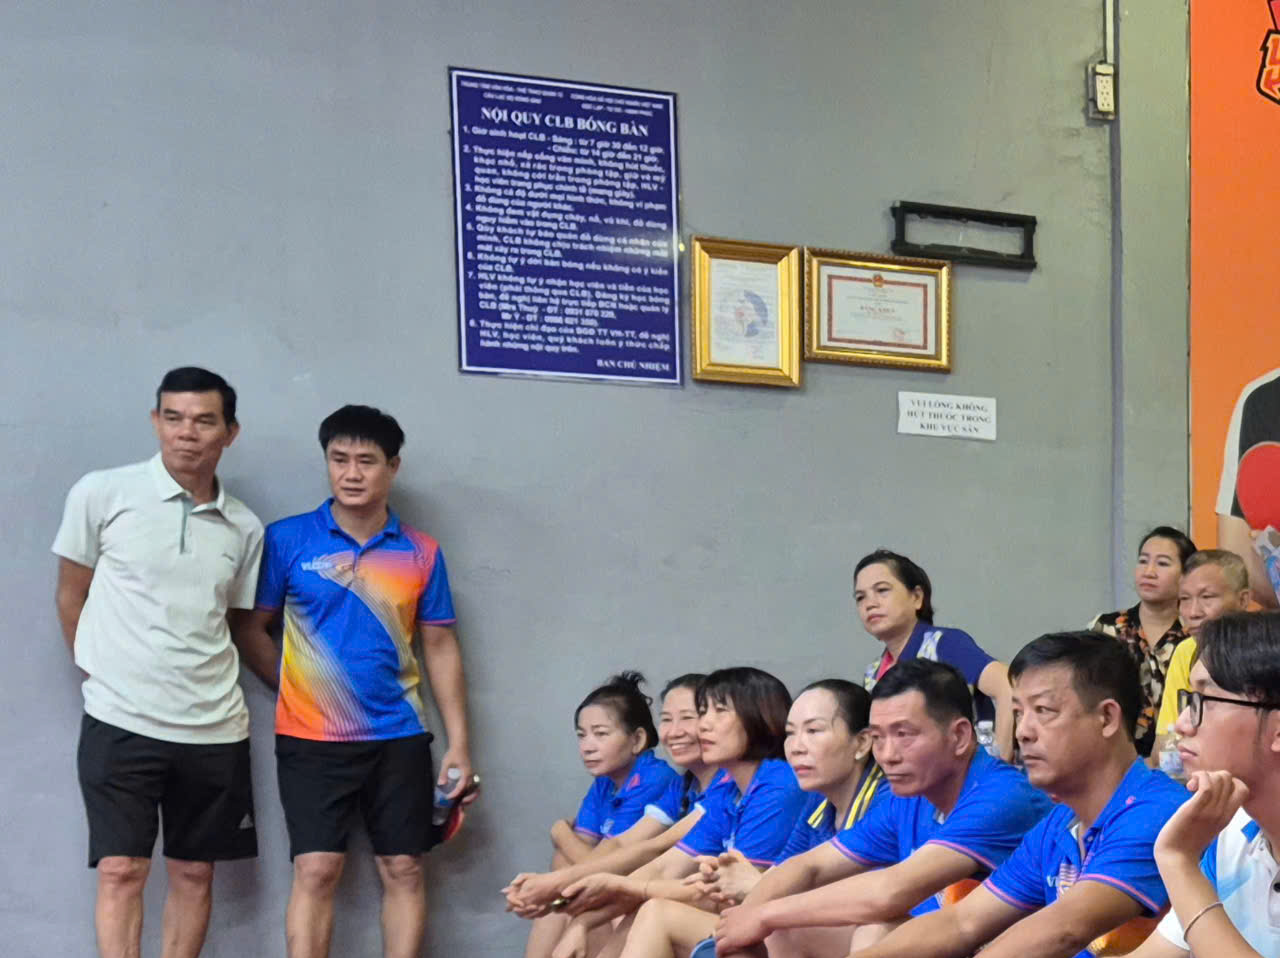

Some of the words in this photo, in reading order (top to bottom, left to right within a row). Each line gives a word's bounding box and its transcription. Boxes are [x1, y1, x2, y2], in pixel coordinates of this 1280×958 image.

[480, 104, 508, 124] NỘI
[510, 109, 542, 128] QUY
[544, 113, 574, 129] CLB
[576, 113, 616, 133] BÓNG
[620, 118, 648, 137] BÀN
